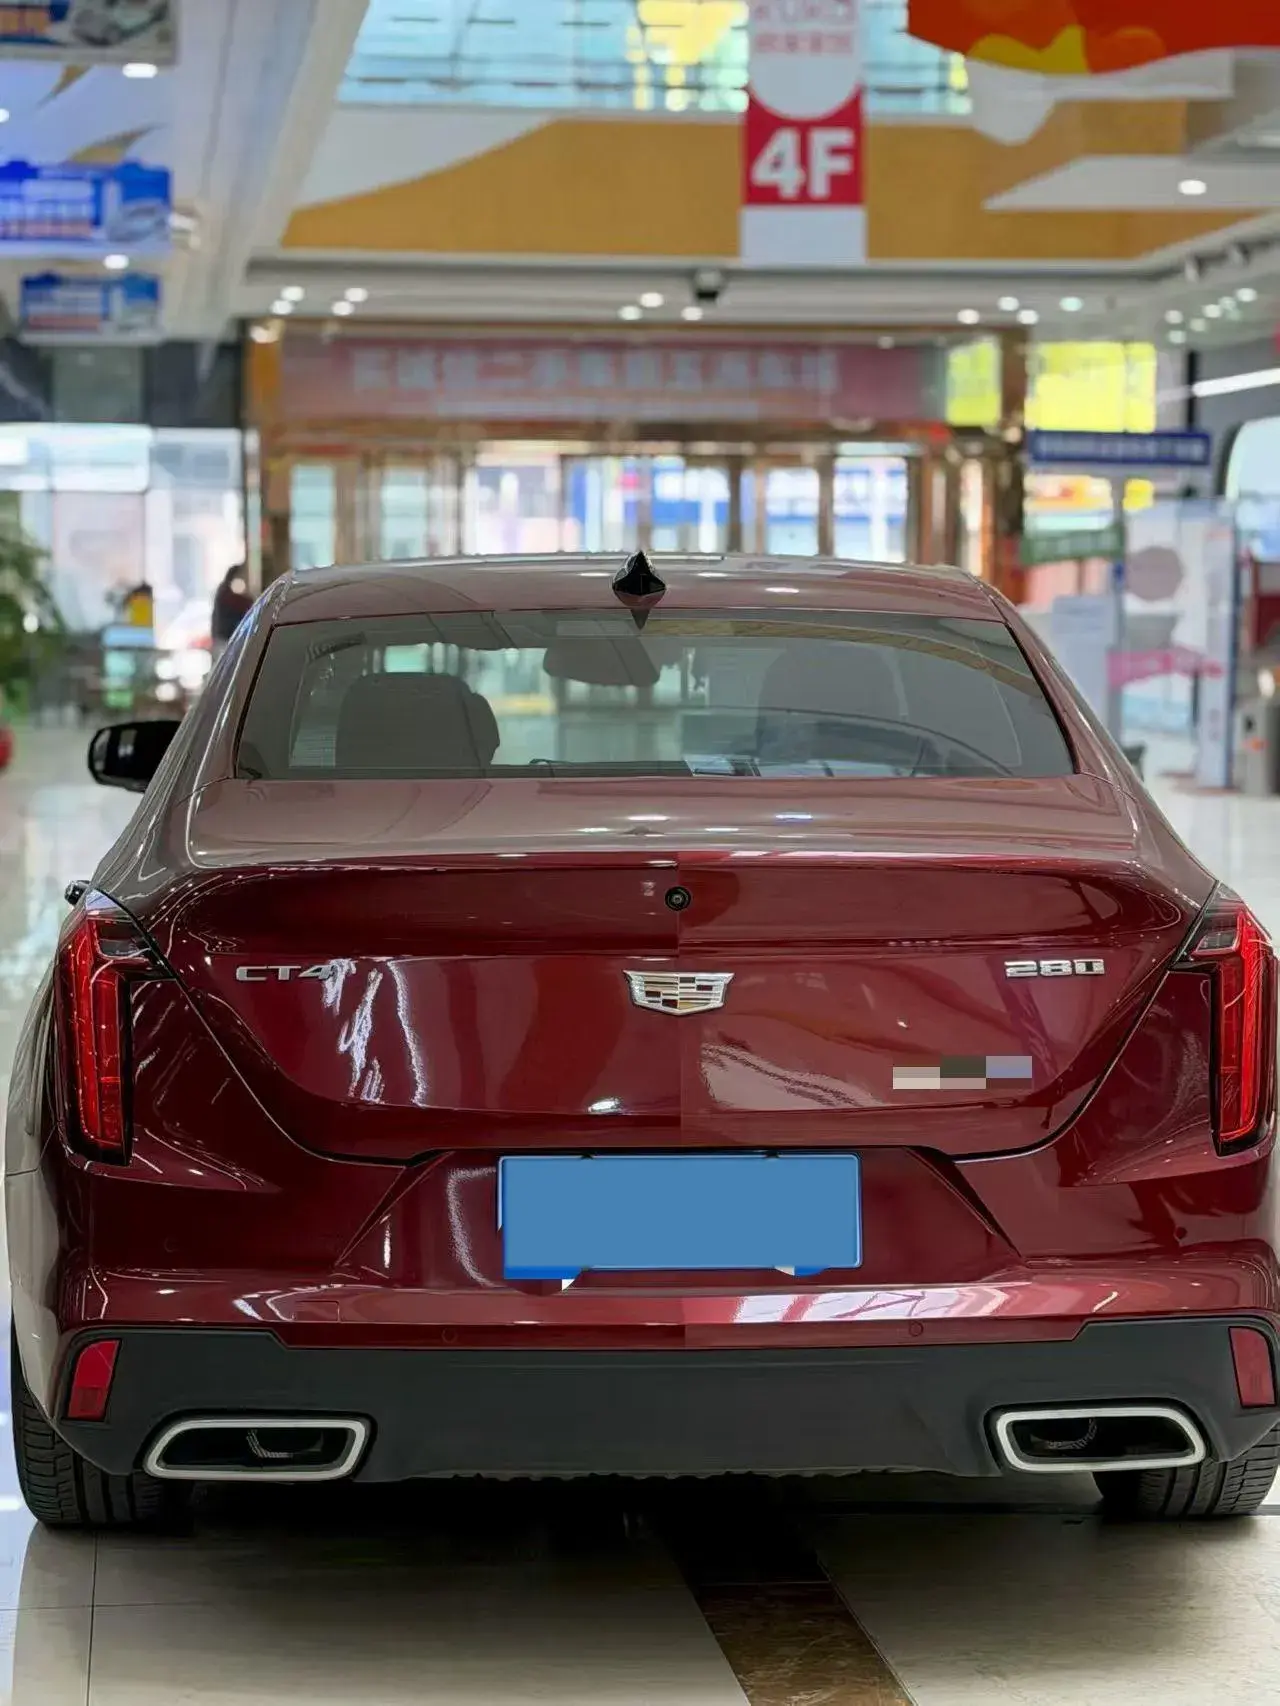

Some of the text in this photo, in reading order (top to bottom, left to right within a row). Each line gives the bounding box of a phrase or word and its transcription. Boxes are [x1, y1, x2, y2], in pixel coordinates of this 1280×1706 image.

[751, 127, 856, 200] 4F
[236, 964, 335, 982] CT4
[1004, 958, 1106, 979] 280
